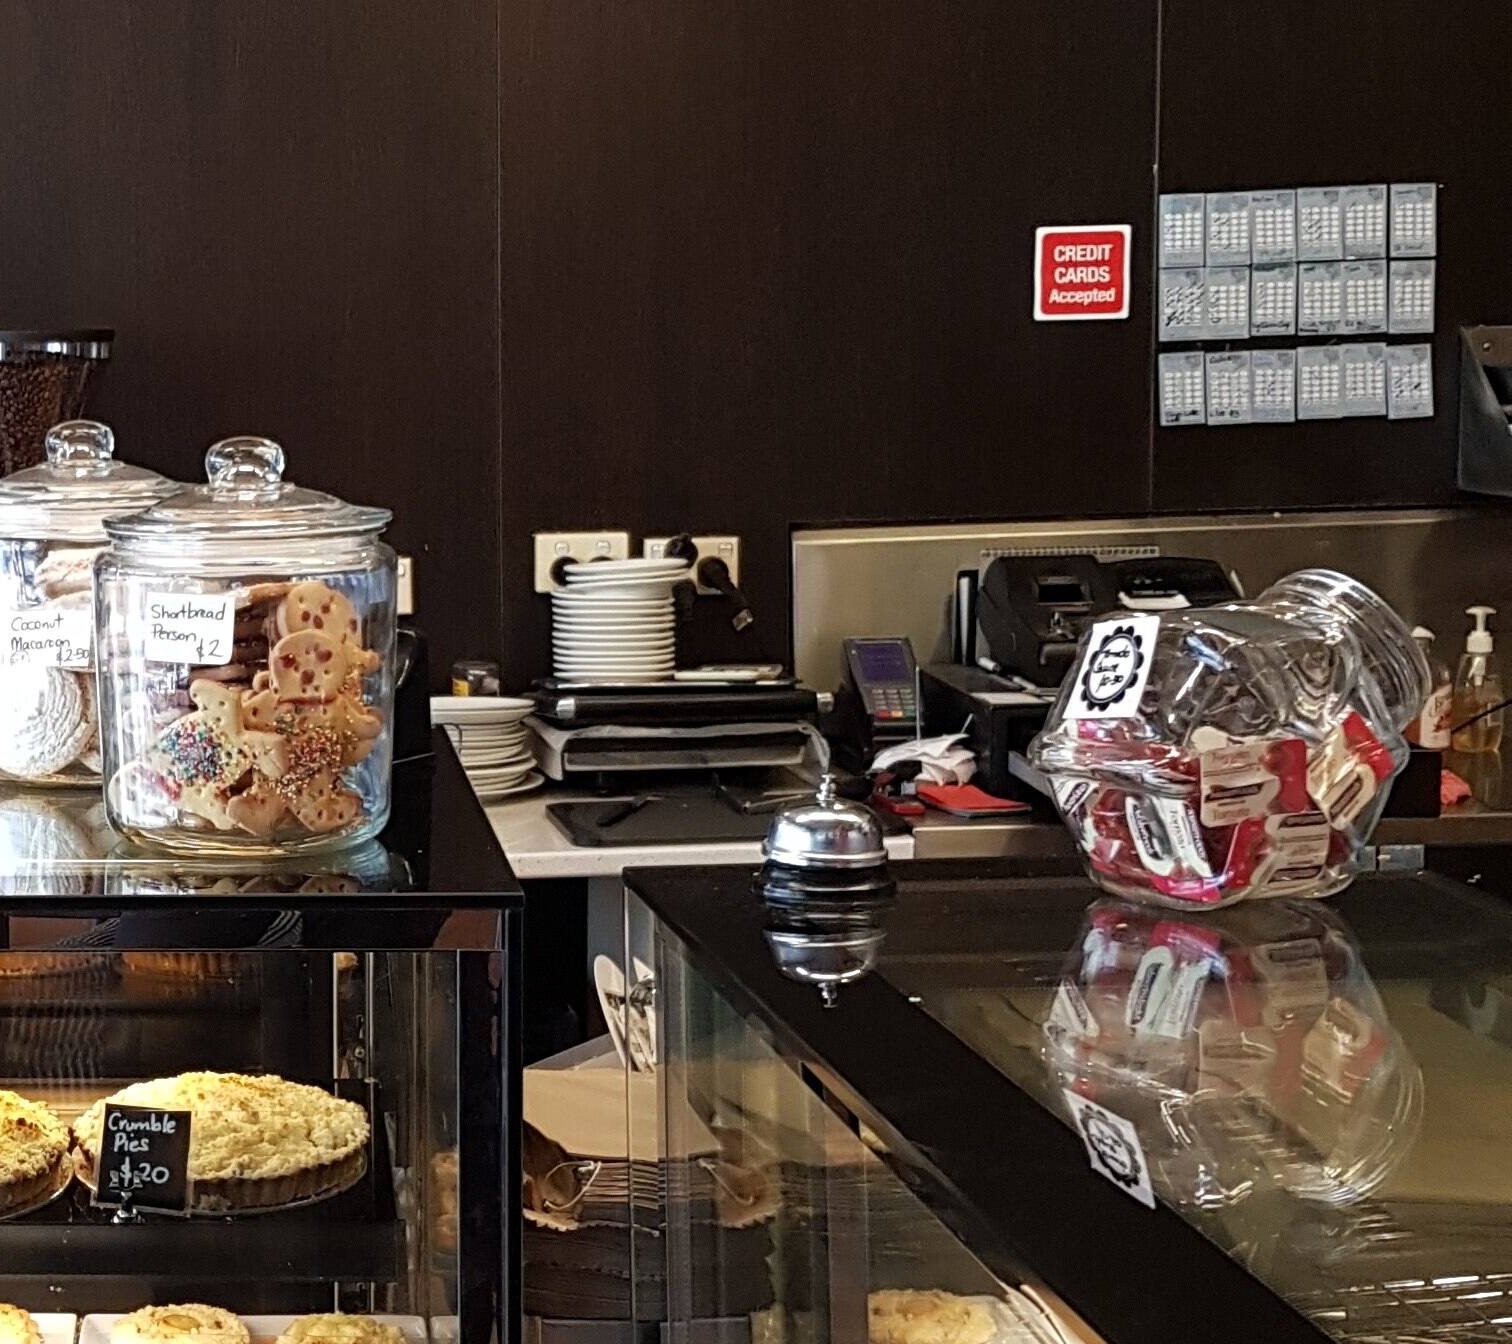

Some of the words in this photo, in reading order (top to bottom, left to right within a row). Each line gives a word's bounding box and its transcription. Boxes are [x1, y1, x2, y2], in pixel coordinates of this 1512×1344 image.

[1053, 244, 1114, 262] CREDIT
[1054, 266, 1111, 284] CARDS
[1048, 288, 1116, 306] Accepted
[150, 601, 226, 621] Shortbread
[11, 613, 64, 632] Coconut
[151, 623, 197, 642] Person
[196, 638, 224, 662] $2
[108, 1112, 177, 1134] Crumble
[113, 1132, 150, 1153] Pies
[119, 1156, 170, 1188] $20
